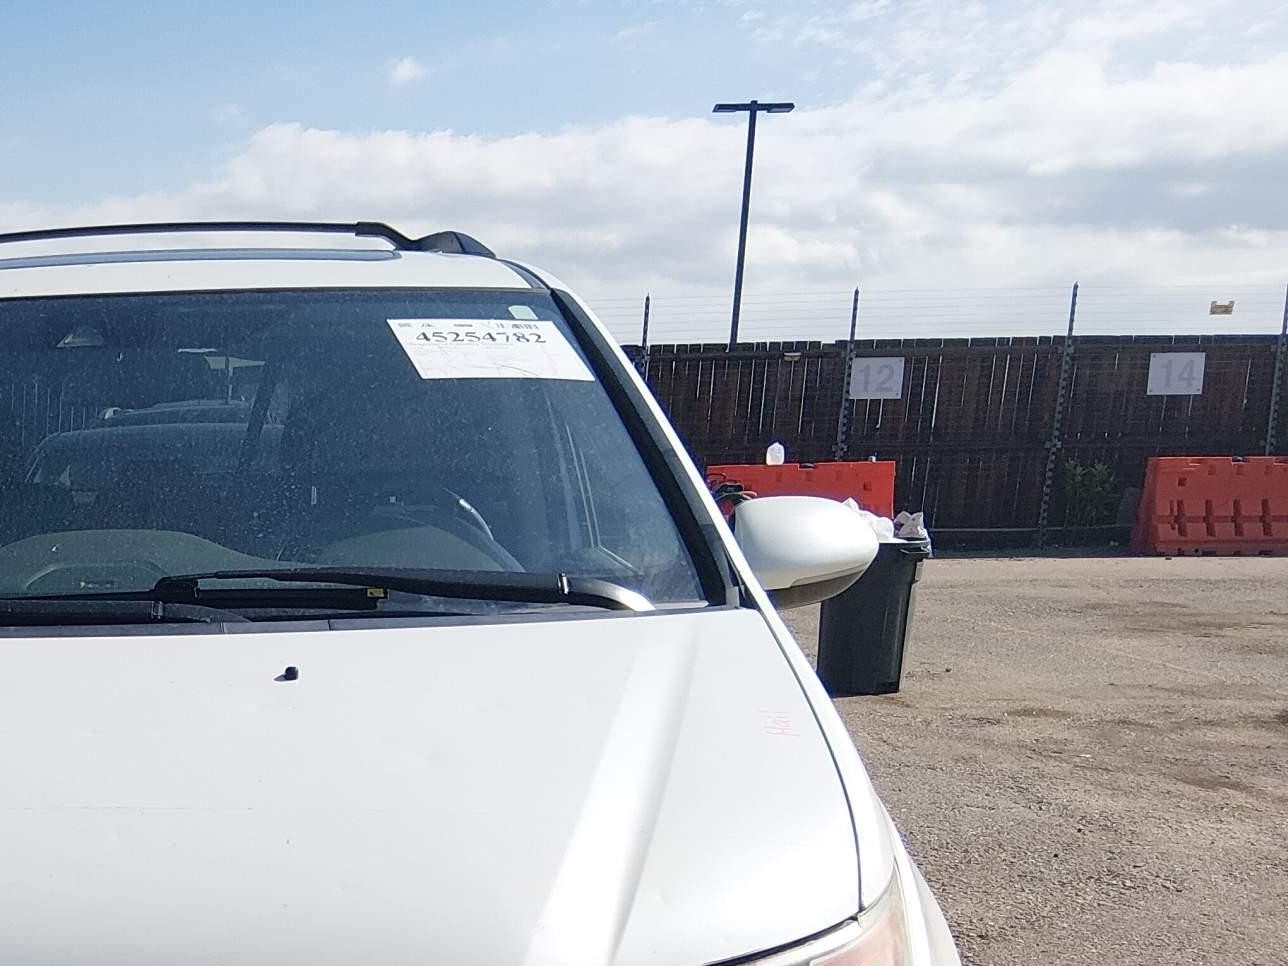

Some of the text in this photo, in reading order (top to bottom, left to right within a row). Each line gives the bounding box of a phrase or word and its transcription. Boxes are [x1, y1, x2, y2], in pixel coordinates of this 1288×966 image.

[415, 330, 547, 344] 45254782
[860, 364, 895, 393] 12
[1159, 358, 1197, 389] 14
